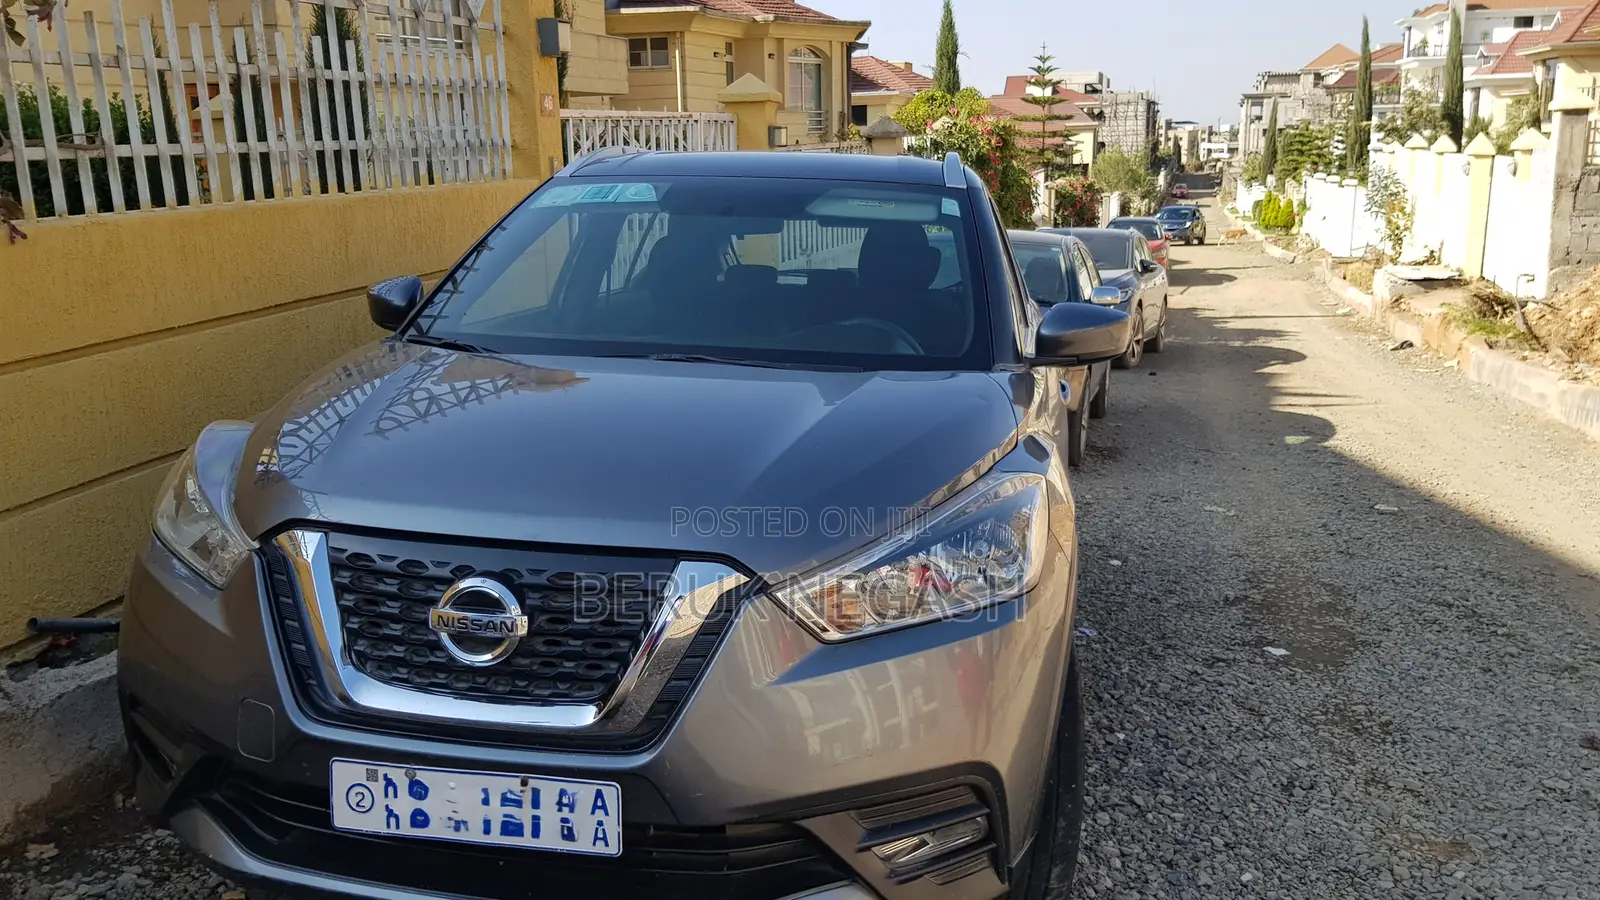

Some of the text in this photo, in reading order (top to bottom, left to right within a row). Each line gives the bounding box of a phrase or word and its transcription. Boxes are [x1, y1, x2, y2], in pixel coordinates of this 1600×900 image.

[543, 94, 553, 110] 46
[435, 613, 515, 634] NISSAN
[354, 791, 366, 808] 2
